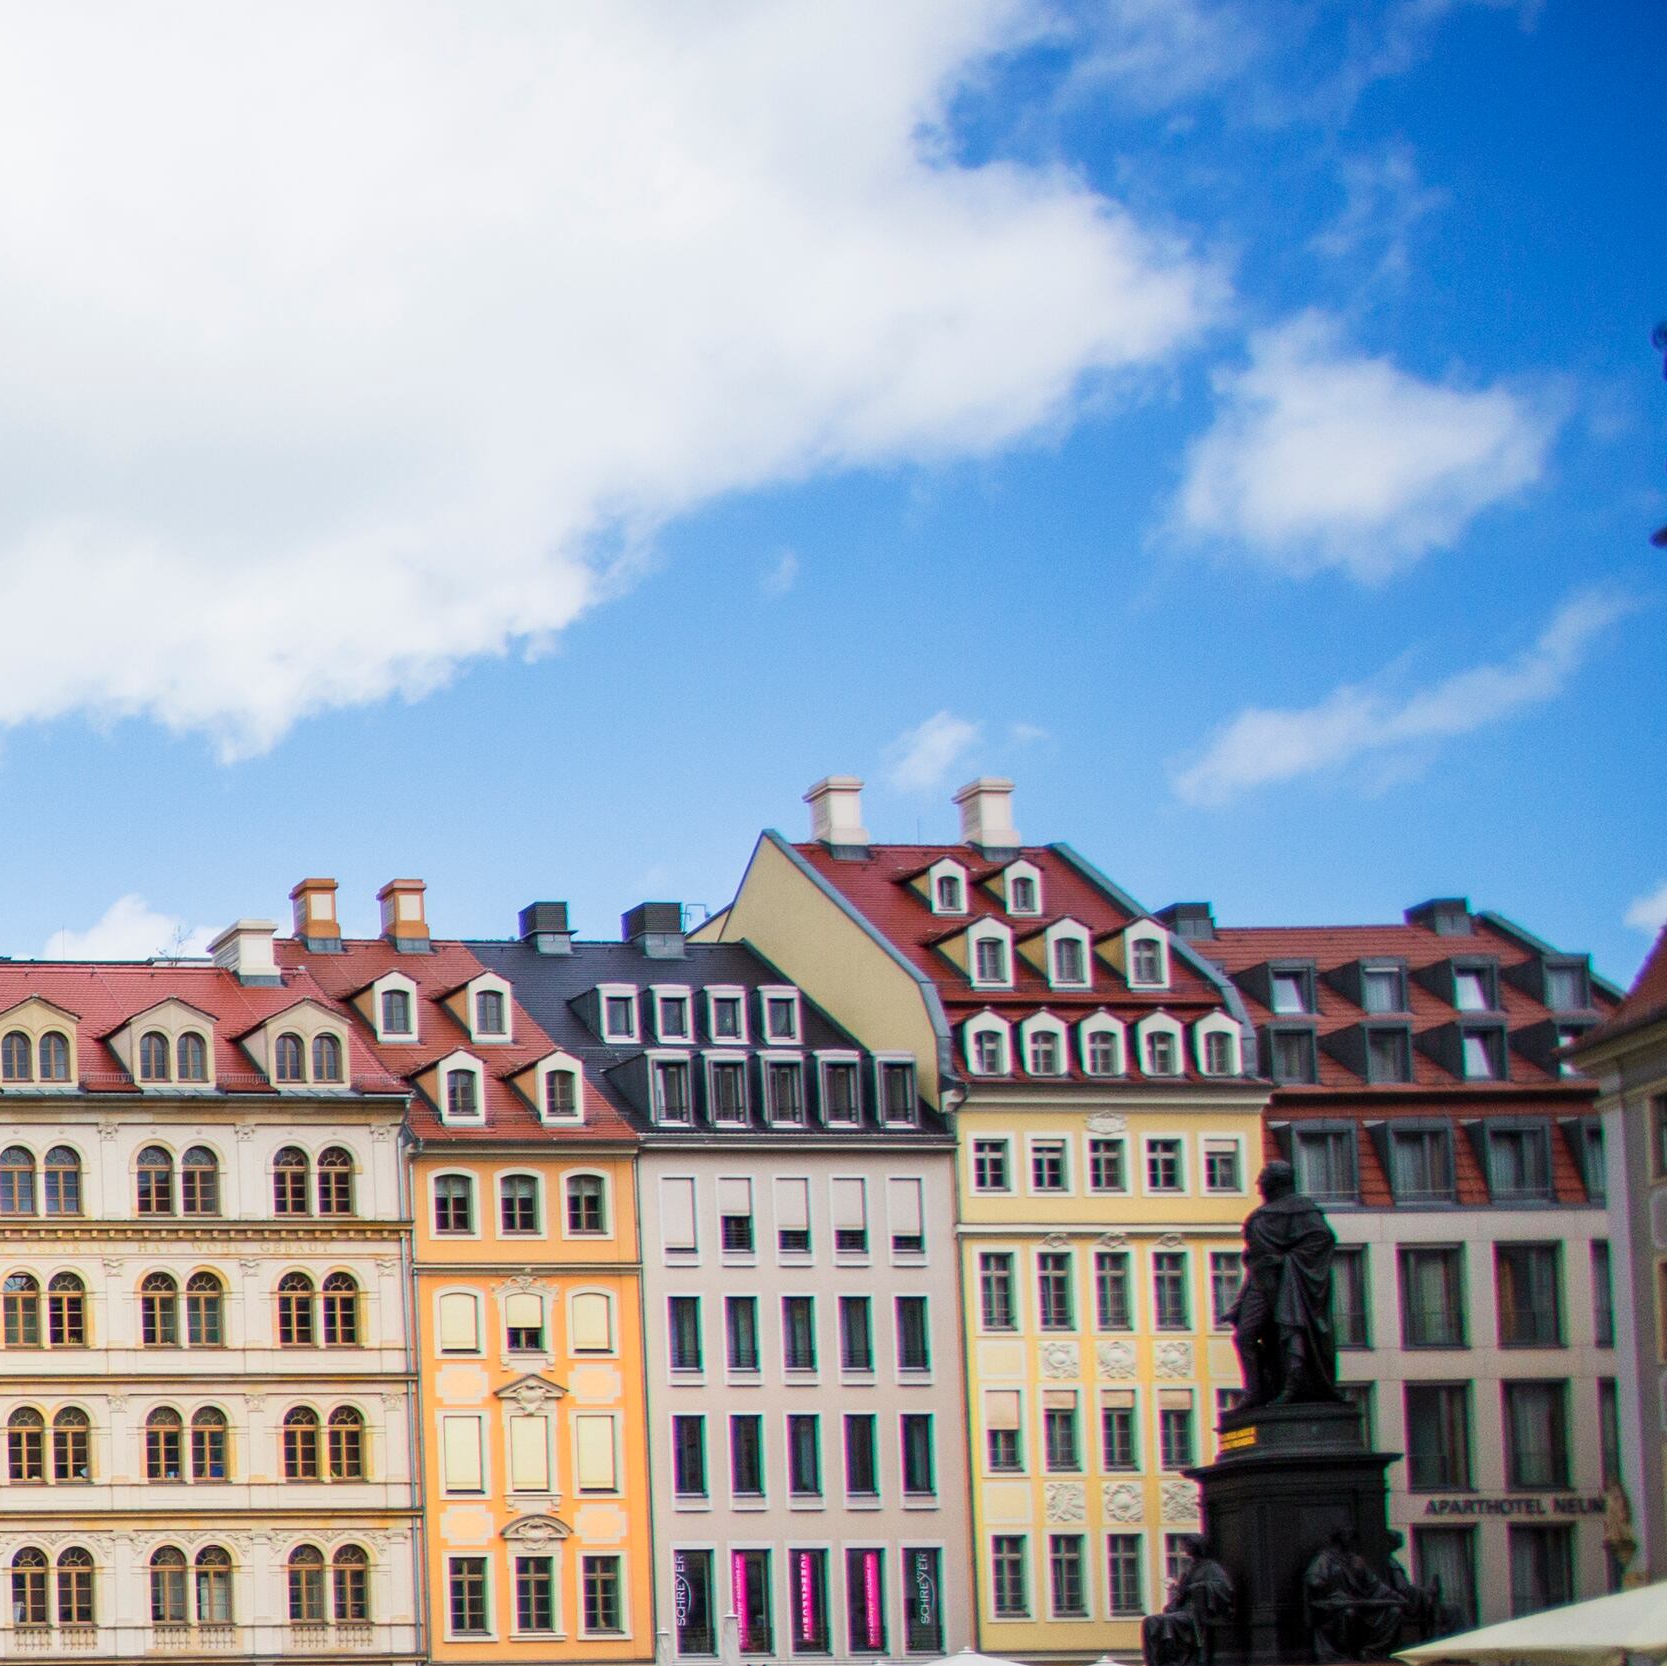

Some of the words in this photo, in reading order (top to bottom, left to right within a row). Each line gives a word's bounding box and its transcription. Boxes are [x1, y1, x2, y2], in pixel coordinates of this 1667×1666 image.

[137, 1242, 172, 1253] HAT
[259, 1242, 330, 1253] GEBAUT
[1424, 1499, 1547, 1515] APARTHOTEL
[675, 1554, 688, 1627] SCHREYER
[917, 1552, 932, 1624] SCHREYER
